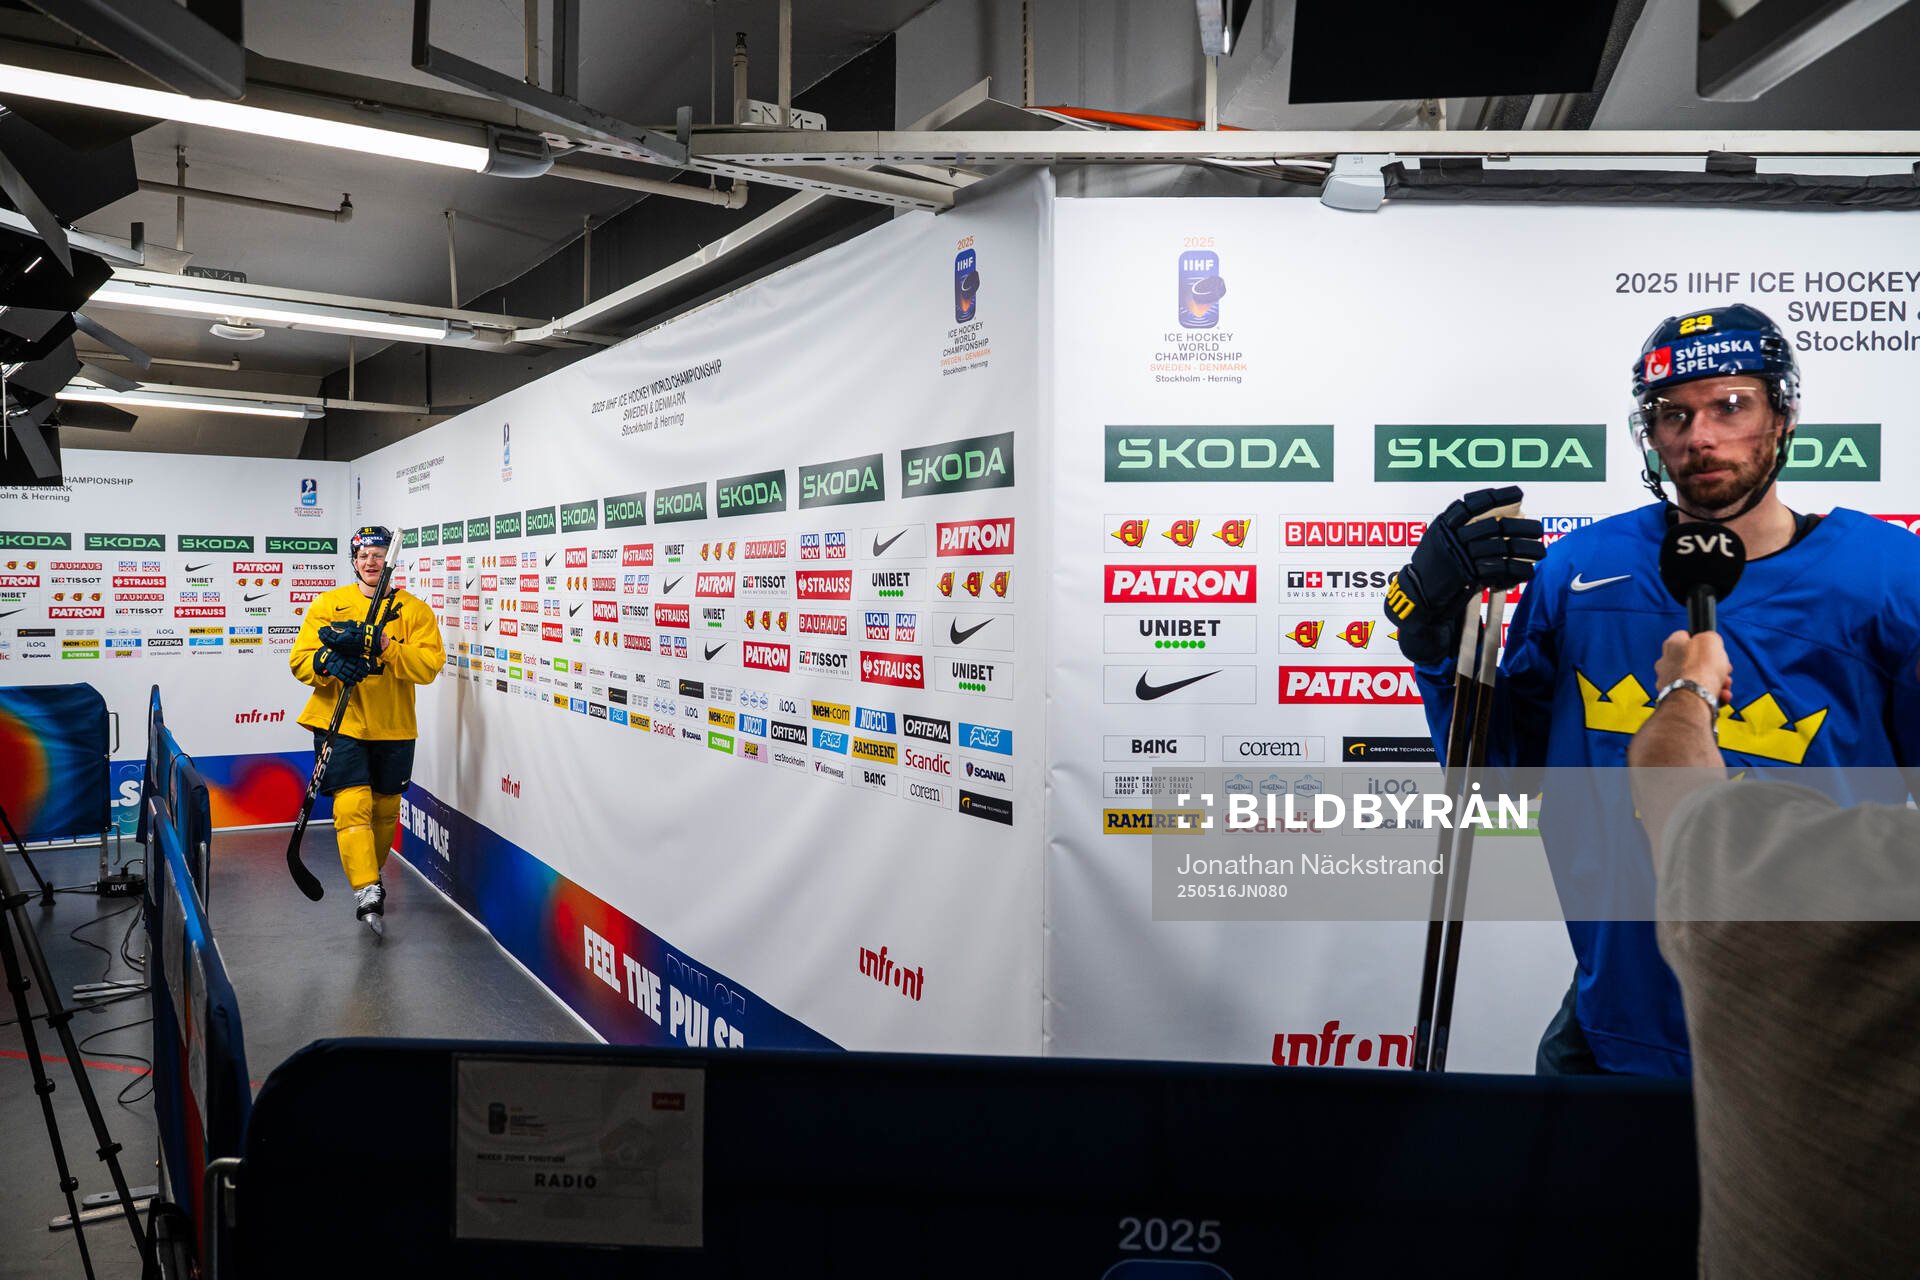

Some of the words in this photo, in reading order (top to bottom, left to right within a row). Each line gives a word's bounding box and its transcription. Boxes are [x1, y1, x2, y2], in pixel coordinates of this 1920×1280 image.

[957, 236, 974, 250] 2025
[1183, 237, 1215, 248] 2025
[957, 257, 973, 272] IIHF
[1183, 259, 1214, 271] IIHF
[1615, 272, 1679, 294] 2025
[1688, 272, 1741, 293] IIHF
[1750, 272, 1795, 293] ICE
[1805, 271, 1920, 293] HOCKEY
[1788, 301, 1906, 322] SWEDEN
[948, 329, 957, 339] ICE
[959, 321, 984, 337] HOCKEY
[1680, 314, 1713, 335] 29
[954, 333, 976, 345] WORLD
[1164, 333, 1183, 342] ICE
[1186, 333, 1233, 342] HOCKEY
[943, 338, 989, 358] CHAMPIONSHIP
[1178, 343, 1219, 352] WORLD
[1676, 340, 1754, 362] SVENSKA
[1155, 352, 1243, 362] CHAMPIONSHIP
[1149, 363, 1192, 372] SWEDEN
[1199, 363, 1247, 372] DENMARK
[1676, 357, 1719, 375] SPEL
[628, 385, 650, 404] HOCKEY
[651, 377, 672, 396] WORLD
[671, 359, 722, 389] CHAMPIONSHIP
[1155, 375, 1200, 383] Stockholm
[1207, 375, 1242, 384] Herning
[623, 405, 648, 421] SWEDEN
[655, 391, 687, 412] DENMARK
[63, 476, 134, 485] HAMPIONSHIP
[32, 493, 70, 502] Herning
[940, 523, 1011, 551] PATRON
[1287, 523, 1425, 544] BAUHAUS
[664, 544, 685, 556] UNIBET
[745, 541, 786, 557] BAUHAUS
[1676, 533, 1735, 557] svt
[628, 547, 653, 562] STRAUSS
[51, 562, 102, 570] BAUHAUS
[235, 563, 281, 572] PATRON
[0, 577, 37, 586] TRON
[123, 578, 165, 586] STRAUSS
[698, 576, 734, 594] PATRON
[755, 576, 786, 589] TISSOT
[808, 577, 850, 594] STRAUSS
[872, 572, 910, 588] UNIBET
[1112, 570, 1249, 599] PATRON
[1327, 571, 1397, 589] TISS
[51, 608, 102, 617] PATRON
[184, 608, 224, 616] STRAUSS
[593, 603, 617, 620] PATRON
[630, 606, 649, 617] TISSOT
[661, 610, 689, 623] STRAUSS
[703, 608, 725, 620] UNIBET
[799, 616, 847, 633] BAUHAUS
[896, 614, 916, 627] LIQUI
[1139, 619, 1221, 637] UNIBET
[867, 628, 889, 640] MOLY
[896, 629, 915, 642] MOLY
[745, 645, 788, 667] PATRON
[811, 652, 848, 668] TISSOT
[873, 659, 921, 681] STRAUSS
[952, 661, 994, 681] UNIBET
[1286, 671, 1422, 700] PATRON
[235, 708, 285, 724] infront
[860, 709, 887, 732] NOCCO
[653, 720, 676, 738] Scandic
[772, 726, 807, 742] ORTEMA
[905, 719, 949, 740] ORTEMA
[853, 740, 895, 759] RAMIRENT
[1131, 739, 1177, 754] BANG
[1239, 741, 1301, 756] corem
[781, 753, 805, 767] Stockholm
[905, 749, 950, 775] Scandic
[864, 771, 886, 786] BANG
[975, 767, 1006, 783] SCANIA
[910, 783, 940, 801] corem
[1368, 777, 1419, 795] iLOQ
[400, 797, 411, 830] EEL
[411, 804, 426, 842] THE
[427, 815, 450, 862] PULSE
[584, 924, 621, 993] FEEL
[623, 953, 662, 1026] THE
[859, 944, 925, 1002] infront
[534, 1173, 598, 1191] RADIO
[1118, 1216, 1222, 1254] 2025
